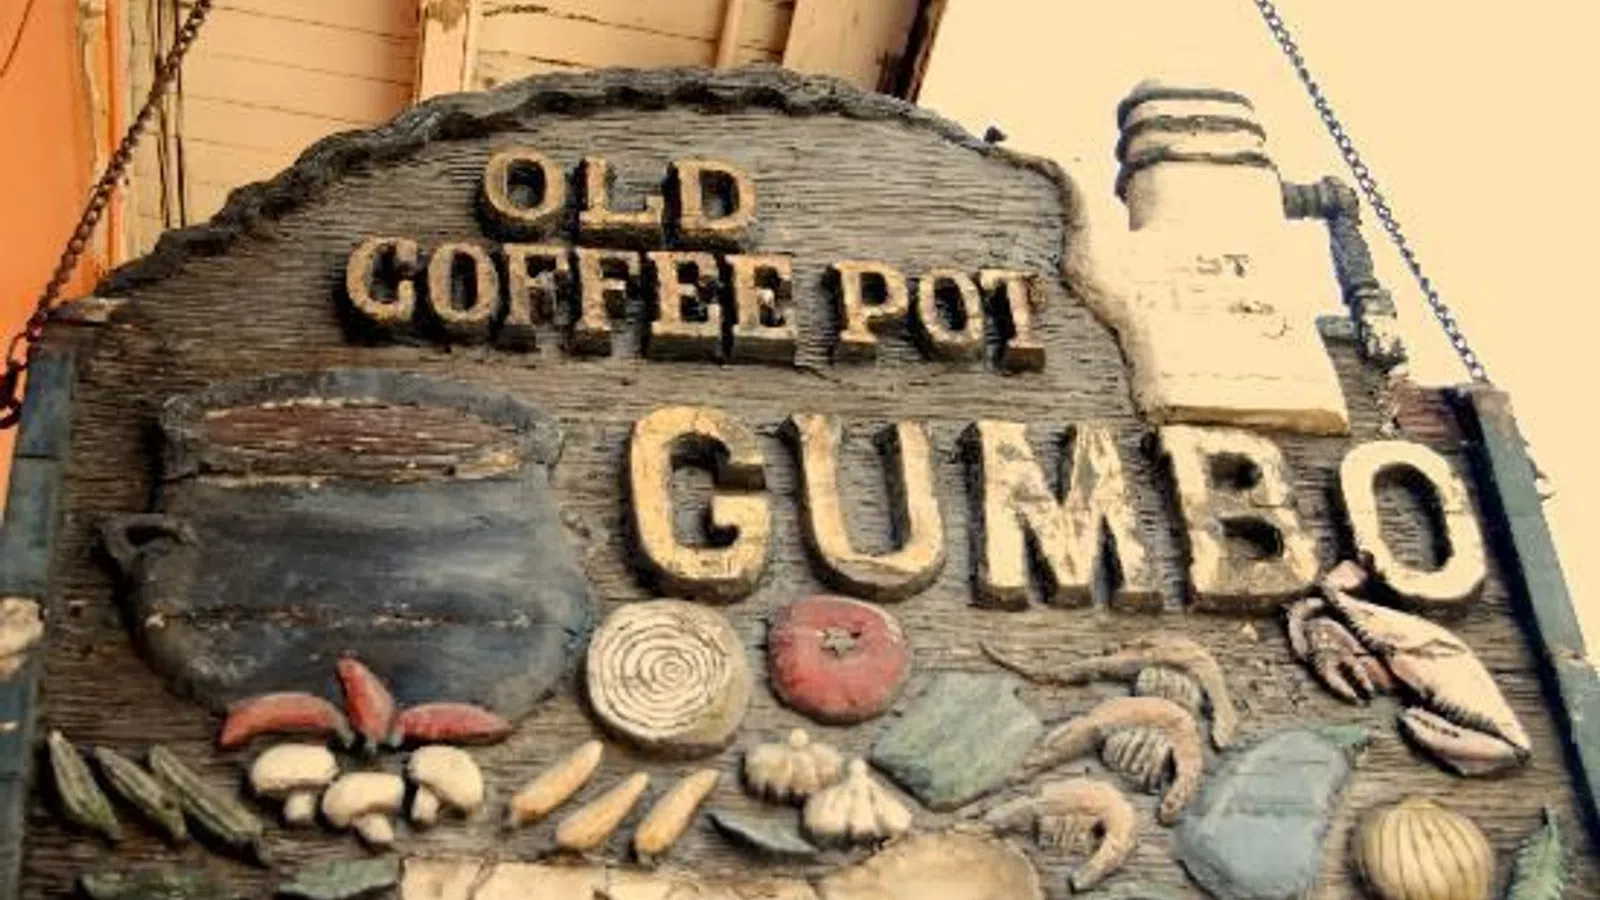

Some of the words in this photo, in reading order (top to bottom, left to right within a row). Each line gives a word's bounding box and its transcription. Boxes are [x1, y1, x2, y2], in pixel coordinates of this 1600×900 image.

[480, 148, 759, 234] OLD
[344, 236, 797, 345] COFFEE
[833, 257, 1048, 355] POT
[628, 404, 1487, 606] GUMBO
